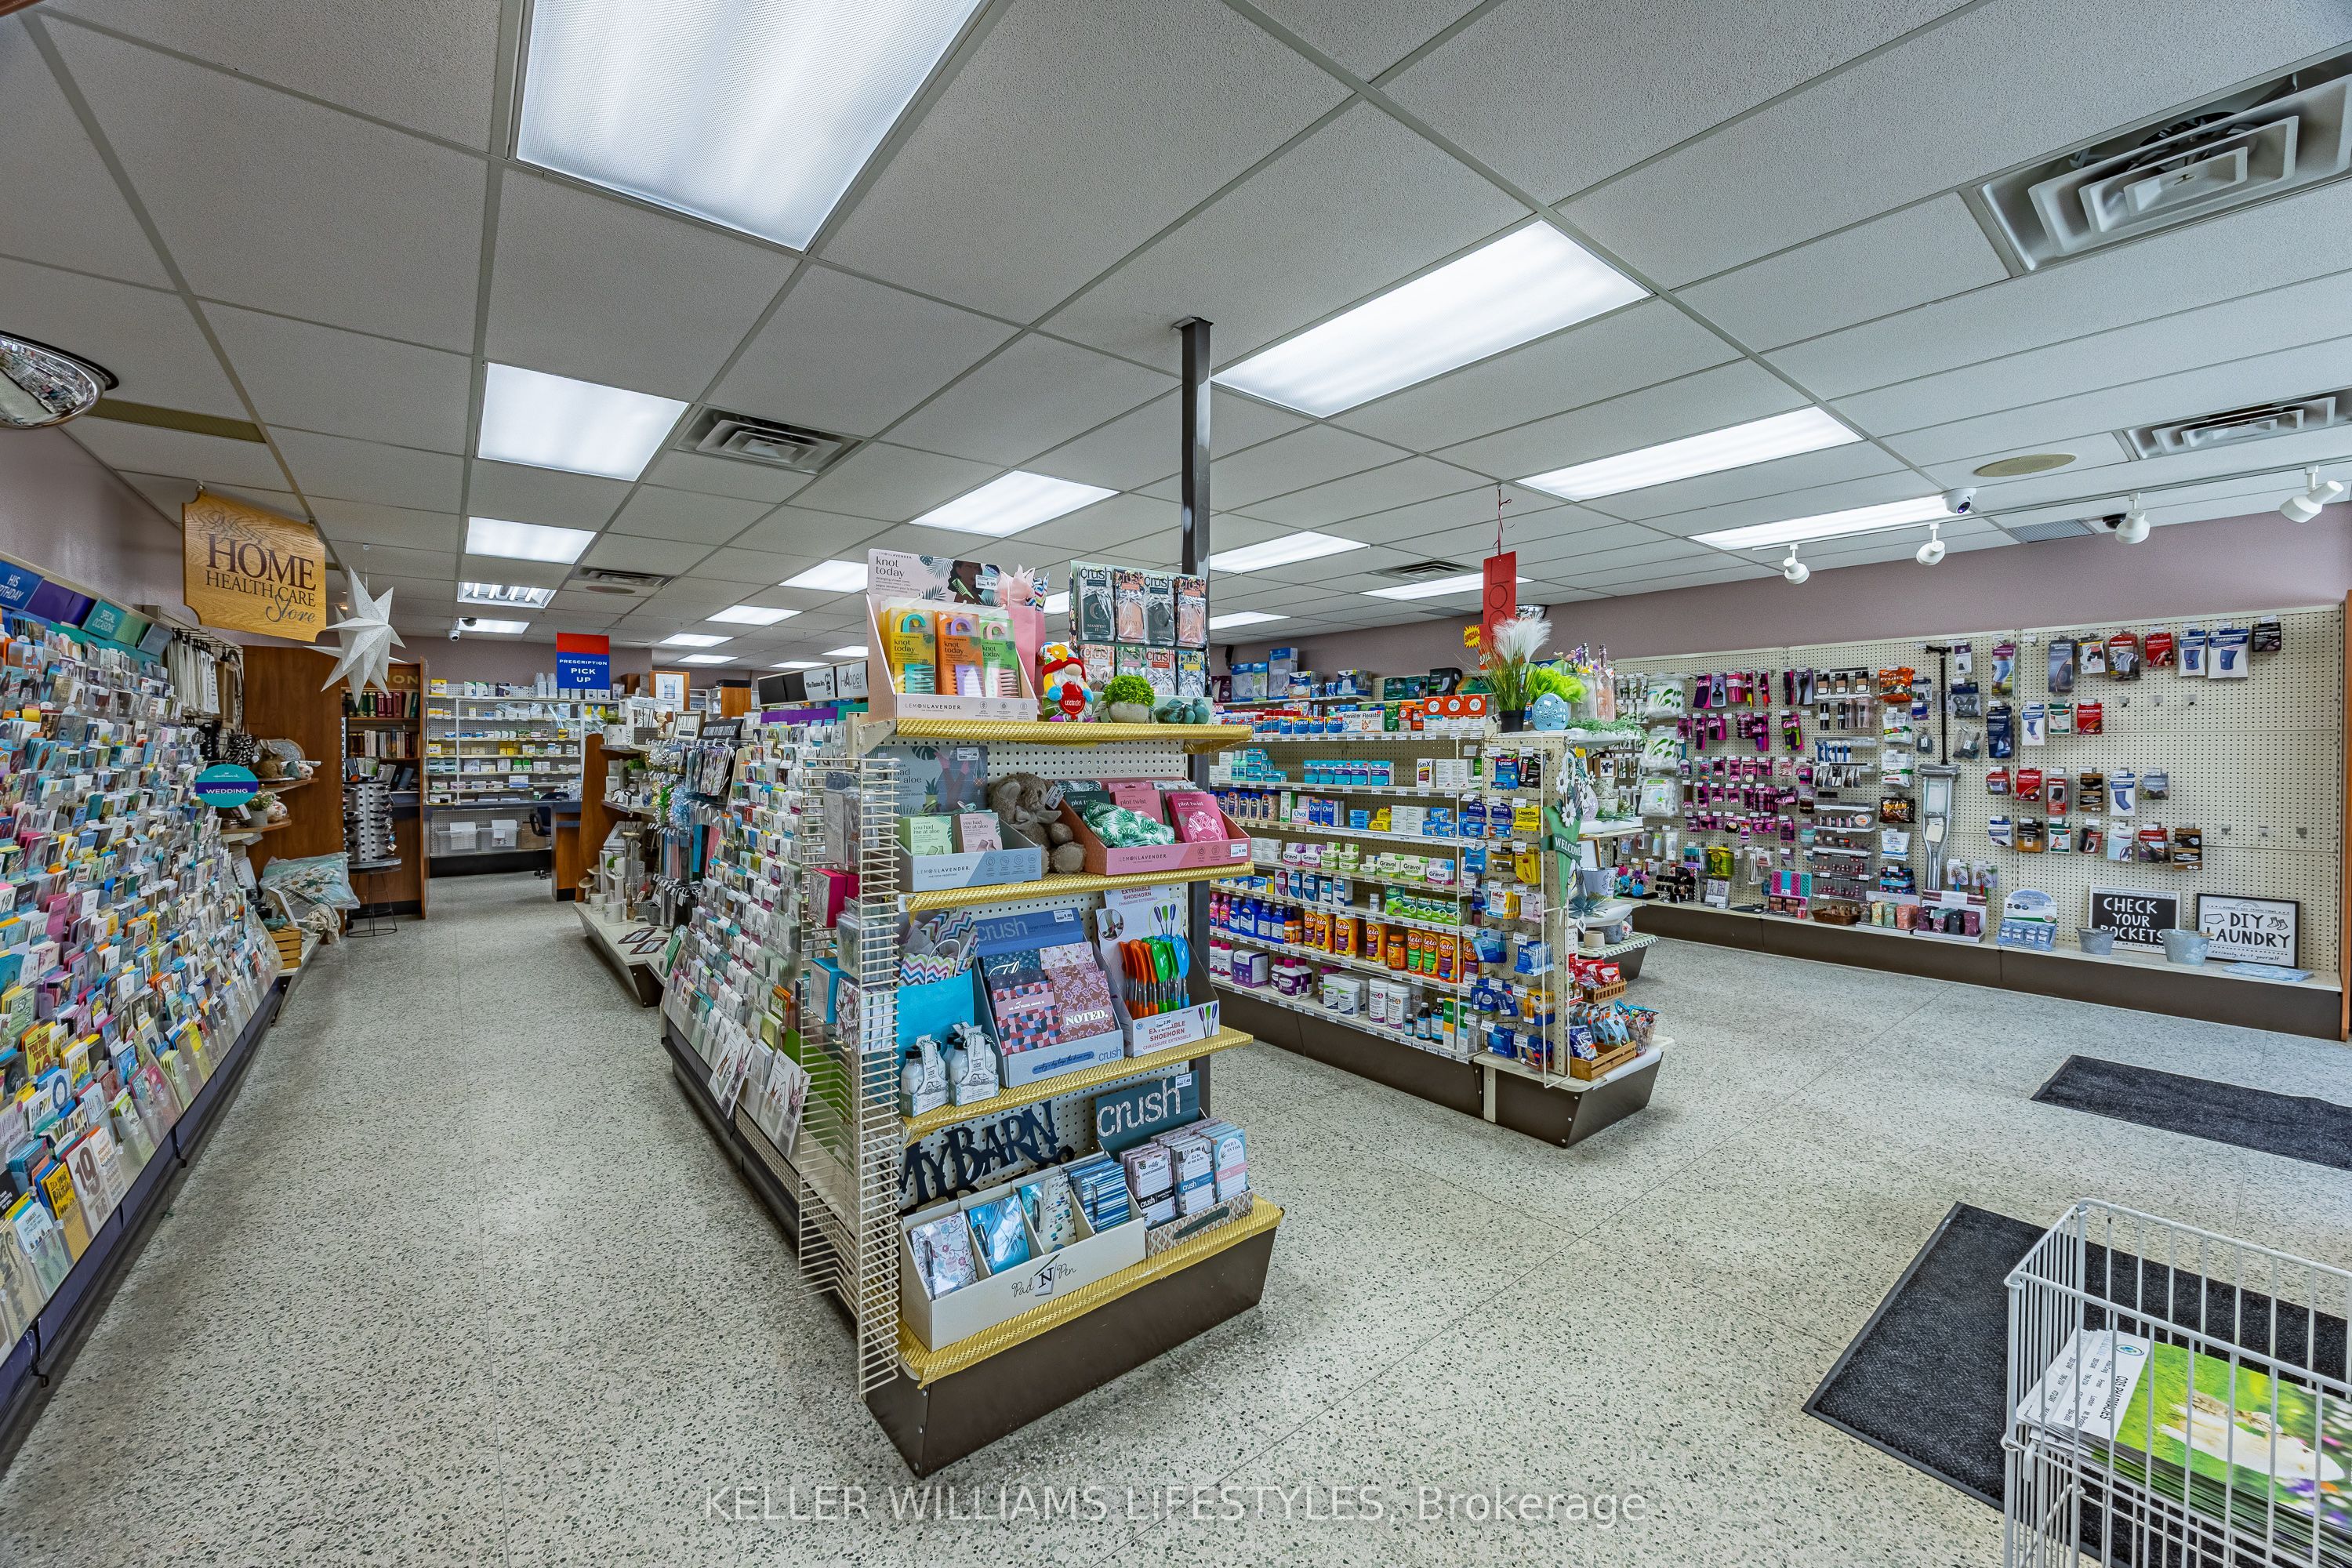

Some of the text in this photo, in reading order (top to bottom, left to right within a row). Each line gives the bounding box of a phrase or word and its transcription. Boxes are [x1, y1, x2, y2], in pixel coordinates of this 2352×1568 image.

[207, 533, 316, 591] HOME
[876, 556, 898, 568] knot
[876, 566, 905, 579] today
[1080, 566, 1112, 580] crush
[6, 574, 21, 587] HIS
[1145, 575, 1175, 588] crush
[206, 570, 316, 608] HEALTH CARE
[266, 593, 316, 622] Store
[1465, 631, 1479, 642] SPECIAL
[1146, 650, 1175, 662] crush
[1555, 837, 1582, 855] WELCOME
[1121, 886, 1151, 895] EXTENABLE
[2103, 897, 2158, 914] CHECK
[1337, 922, 1350, 931] Meta
[2112, 913, 2150, 927] YOUR
[2230, 912, 2264, 930] DIY
[979, 918, 1028, 942] crush
[2207, 927, 2291, 949] LAUNDRY
[1065, 1009, 1108, 1025] NOTED.
[1149, 1021, 1186, 1035] EXABLE
[1142, 1034, 1192, 1051] CHAUSSURE EXTENSIBLE
[1149, 1029, 1185, 1042] SHOEHORN
[1098, 1047, 1122, 1062] crush
[31, 1094, 52, 1123] HAPPY
[1097, 1077, 1181, 1138] crush
[1218, 1171, 1232, 1180] crush
[1182, 1181, 1197, 1192] crush
[1140, 1198, 1156, 1209] crush
[1234, 1207, 1253, 1220] crush
[1011, 1263, 1077, 1298] Pad N Pen
[2087, 1395, 2097, 1406] London
